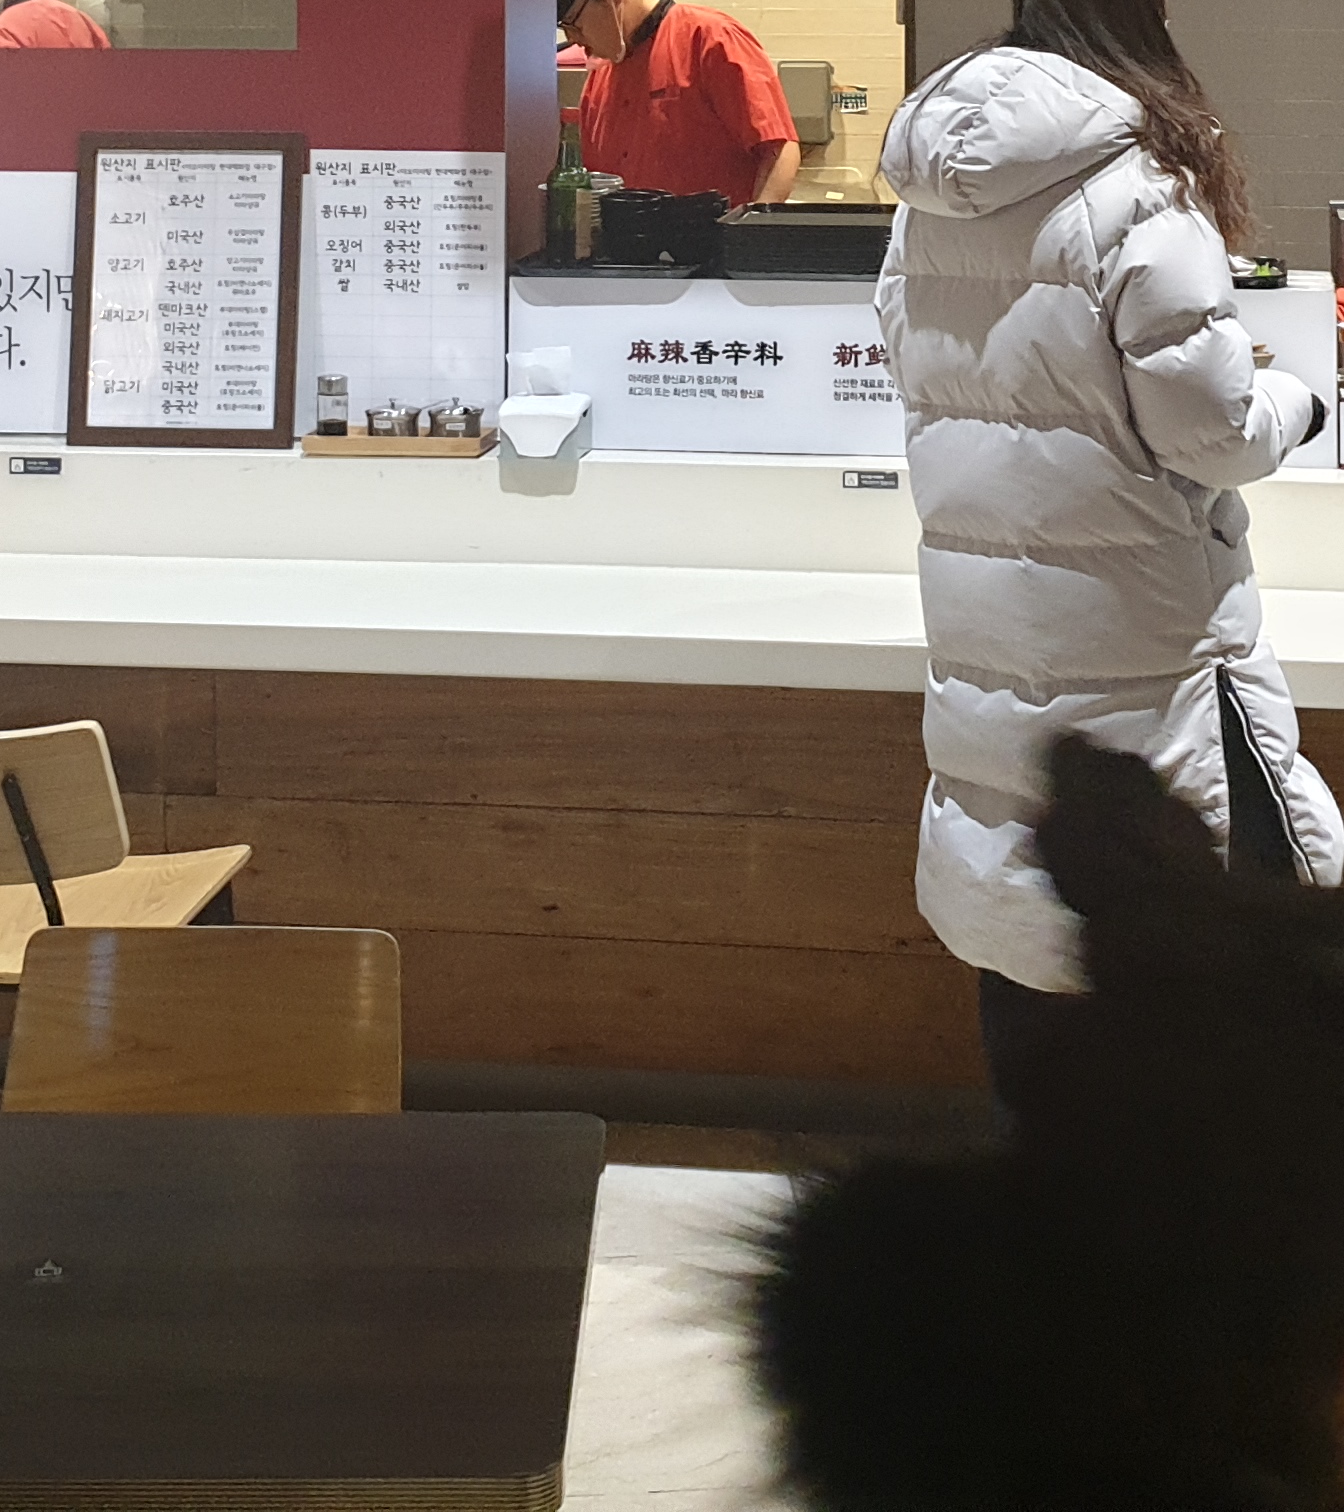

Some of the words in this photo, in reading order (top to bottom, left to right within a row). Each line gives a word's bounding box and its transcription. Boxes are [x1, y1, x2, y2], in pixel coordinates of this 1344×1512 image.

[101, 158, 136, 172] 원산지
[144, 158, 181, 171] 표시판
[316, 162, 351, 176] 원산지
[360, 162, 396, 176] 표시판
[168, 194, 205, 208] 호주산
[384, 196, 421, 210] 중국산
[109, 211, 146, 225] 소고기
[321, 204, 367, 219] 콩(두부)
[384, 220, 421, 234] 외국산
[167, 230, 203, 244] 미국산
[325, 239, 363, 252] 오징어
[384, 240, 421, 253] 중국산
[108, 258, 145, 272] 양고기
[165, 258, 203, 272] 호주산
[331, 259, 356, 272] 갈치
[383, 259, 420, 273] 중국산
[165, 281, 203, 295] 국내산
[337, 279, 350, 292] 쌀
[383, 279, 420, 293] 국내산
[158, 303, 208, 318] 덴마크산
[164, 322, 201, 336] 미국산
[163, 341, 200, 355] 외국산
[627, 339, 784, 366] 麻辣香辛料
[162, 361, 199, 375] 국내산
[103, 380, 140, 394] 닭고기
[162, 381, 199, 395] 미국산
[833, 378, 859, 388] 신선한
[162, 400, 199, 414] 중국산
